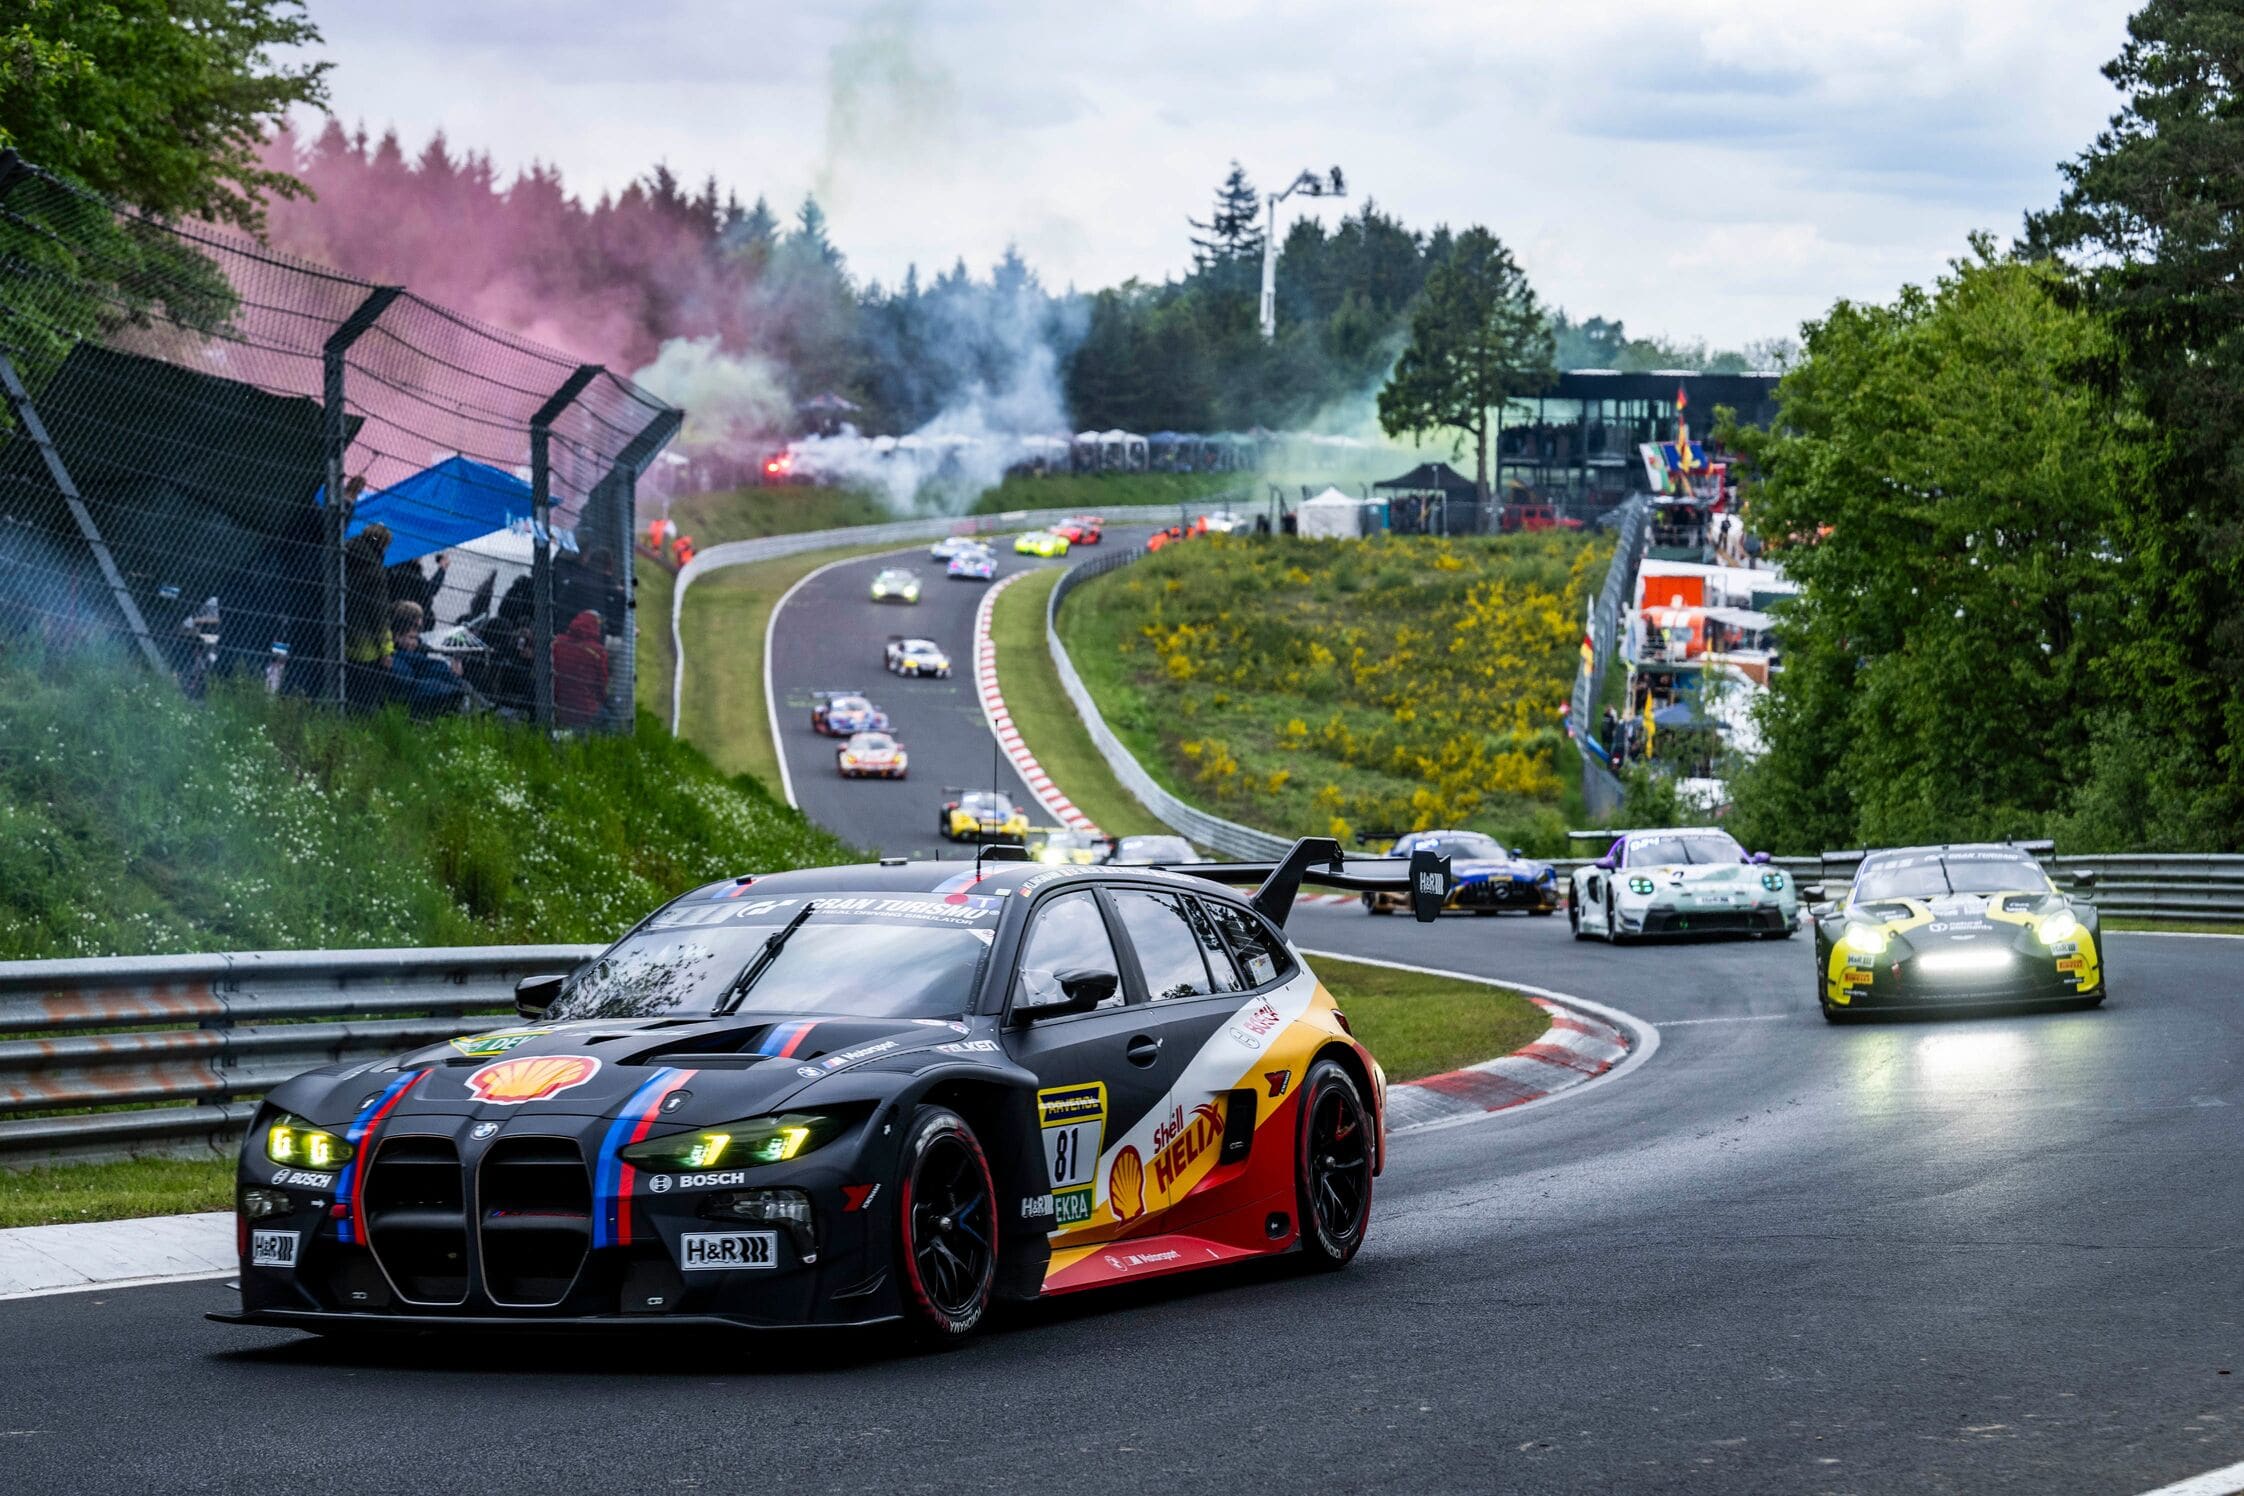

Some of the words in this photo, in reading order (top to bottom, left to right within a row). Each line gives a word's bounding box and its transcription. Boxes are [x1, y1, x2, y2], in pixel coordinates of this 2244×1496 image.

[800, 898, 870, 911] GRAN
[854, 910, 902, 918] DRIVING
[904, 912, 975, 926] SIMULATOR
[845, 1040, 900, 1061] Motorsport
[935, 1039, 1001, 1054] FALKEN
[1047, 1095, 1099, 1115] RAVENOL
[1154, 1104, 1184, 1154] Shell
[1054, 1127, 1079, 1182] 81
[1154, 1103, 1225, 1195] HELIX
[288, 1173, 333, 1188] BOSCH
[680, 1172, 745, 1188] BOSCH
[1055, 1193, 1088, 1222] EKRA
[255, 1235, 278, 1258] H&R
[687, 1237, 738, 1262] H&R
[1136, 1249, 1181, 1266] Motorsport
[948, 1308, 983, 1334] YOKOHAMA
